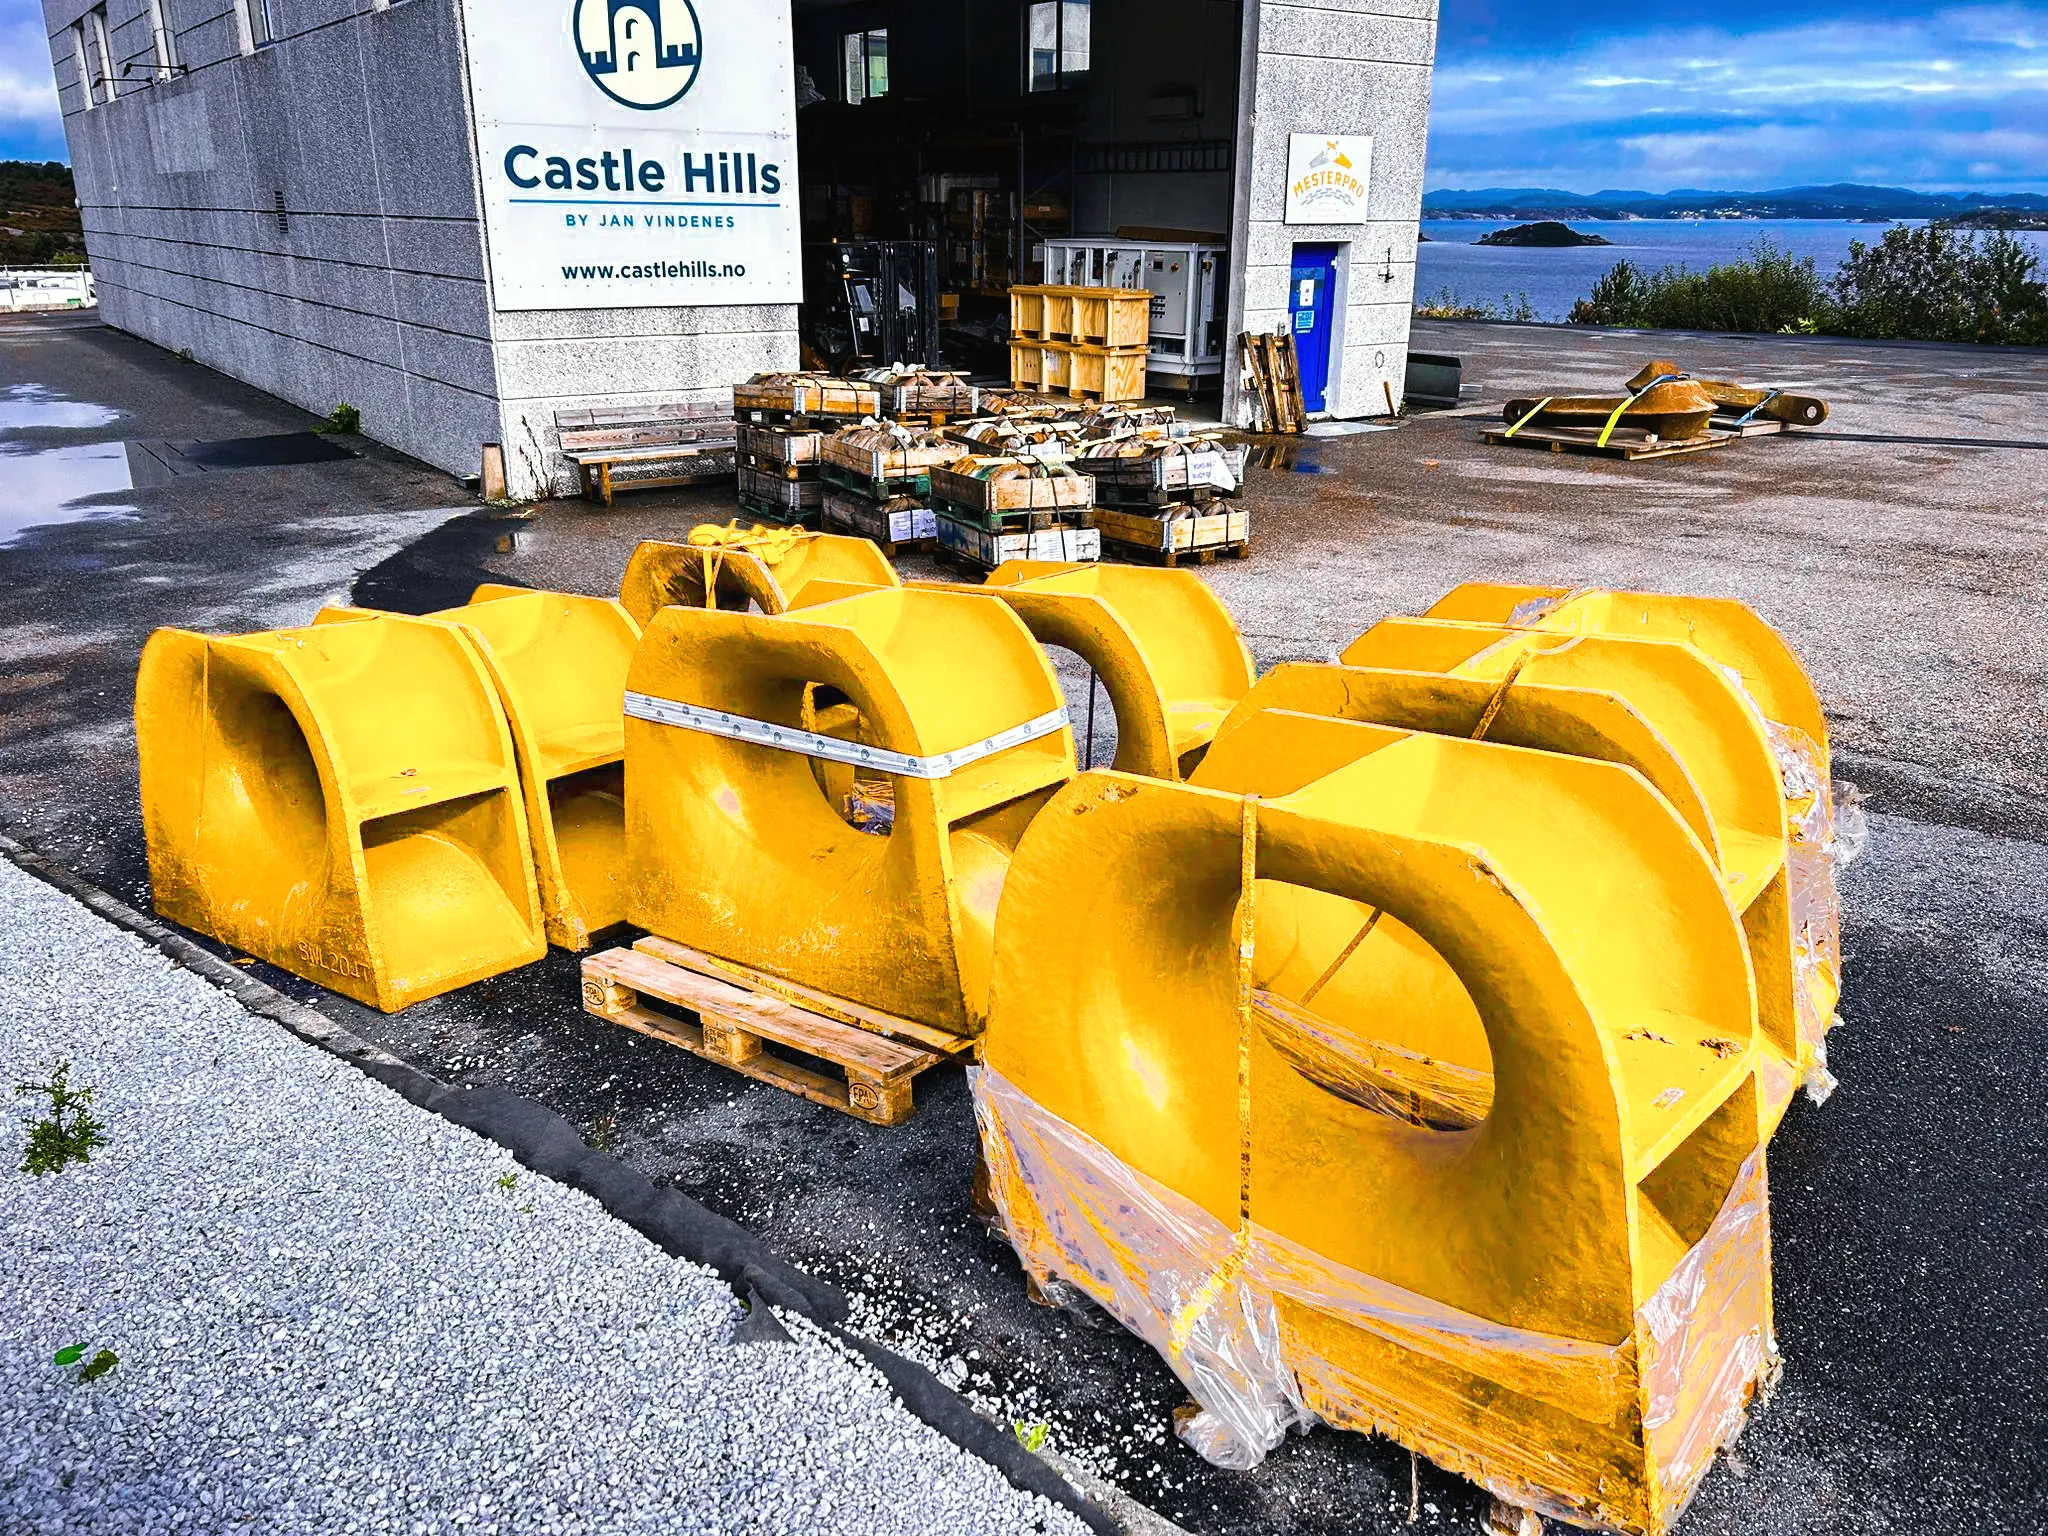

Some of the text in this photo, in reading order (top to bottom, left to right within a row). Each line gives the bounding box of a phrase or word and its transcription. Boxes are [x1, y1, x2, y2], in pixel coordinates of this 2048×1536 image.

[504, 145, 781, 194] Castle Hills
[1293, 170, 1365, 198] MESTERPRO
[565, 214, 735, 228] BY JAN VINDENES
[561, 260, 746, 280] www.castlehills.no
